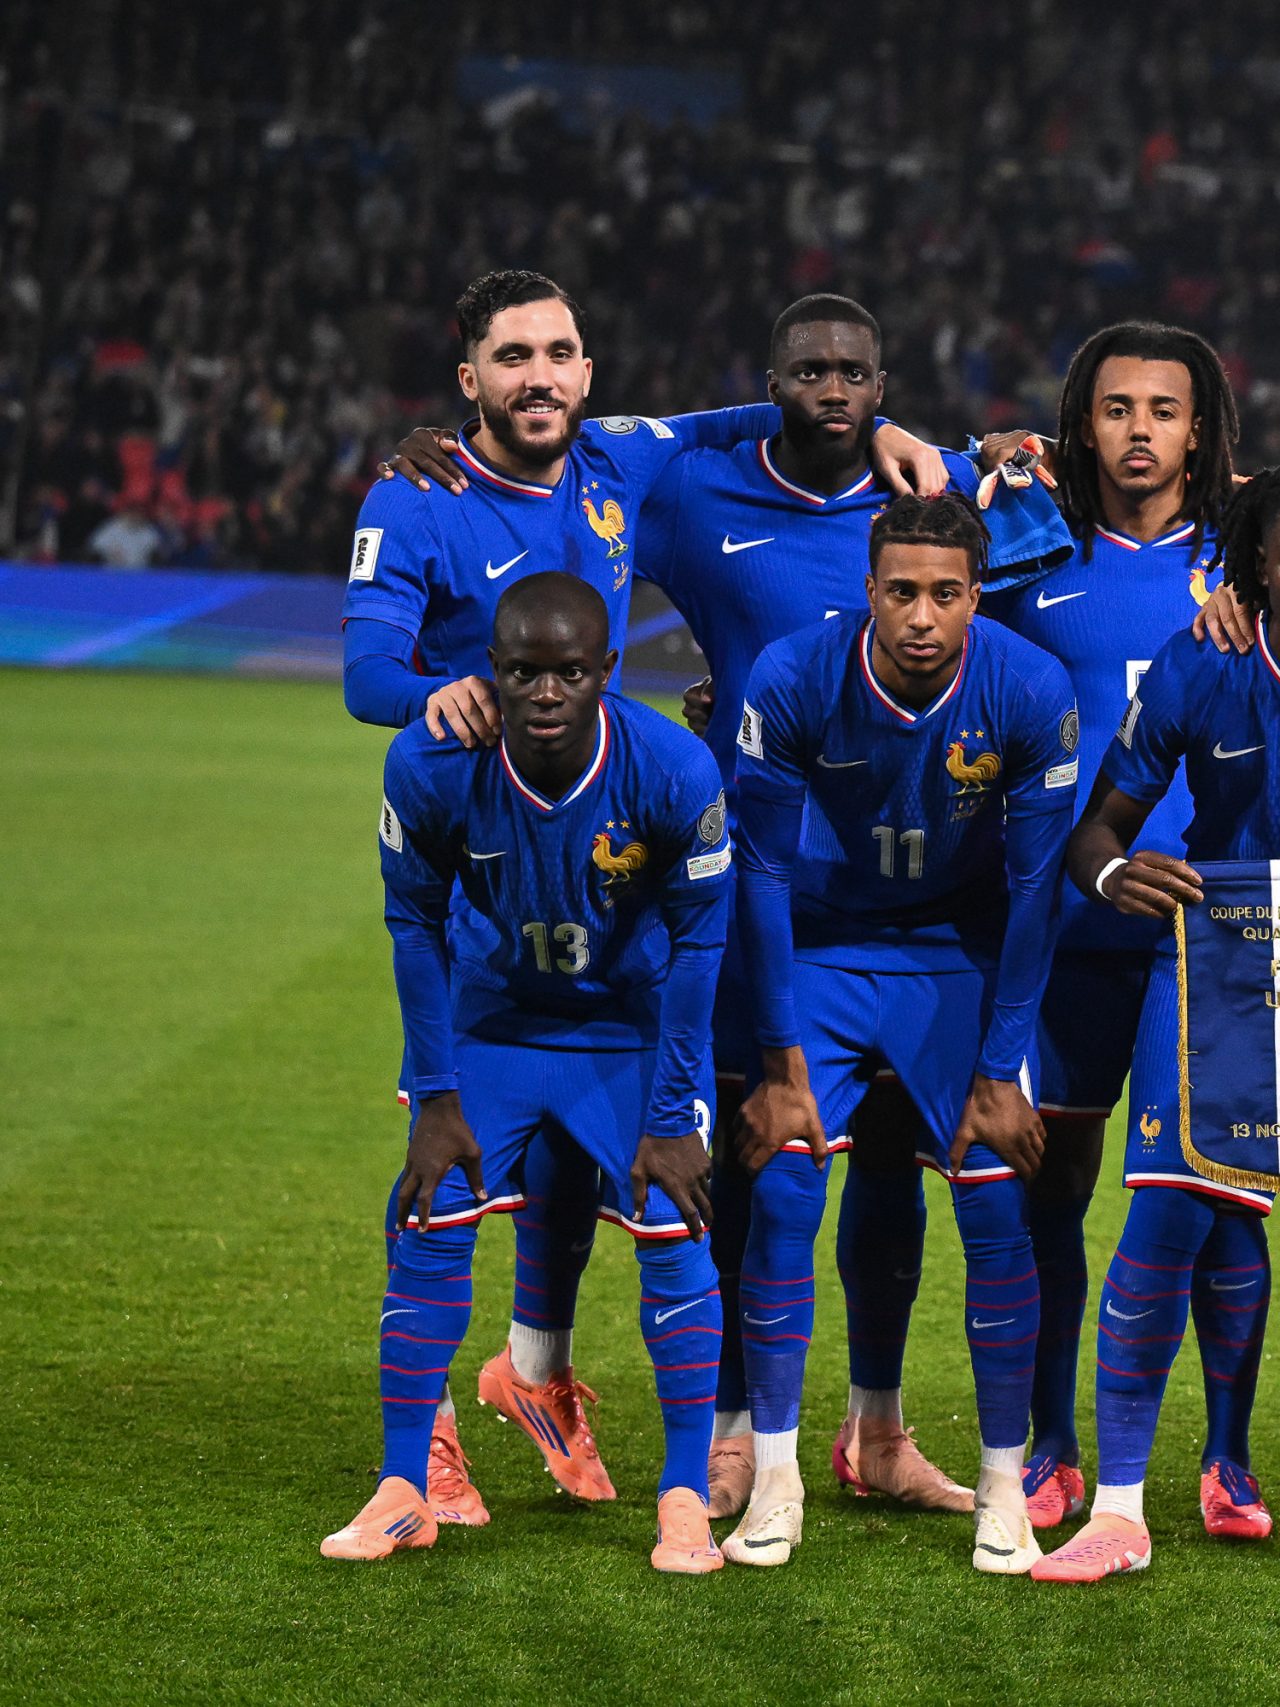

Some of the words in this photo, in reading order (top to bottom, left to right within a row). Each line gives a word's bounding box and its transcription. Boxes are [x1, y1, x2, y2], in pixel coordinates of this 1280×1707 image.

[872, 825, 925, 879] 11
[1210, 906, 1253, 920] COUPE
[1256, 906, 1273, 918] DU
[522, 921, 590, 974] 13
[1230, 1123, 1251, 1138] 13
